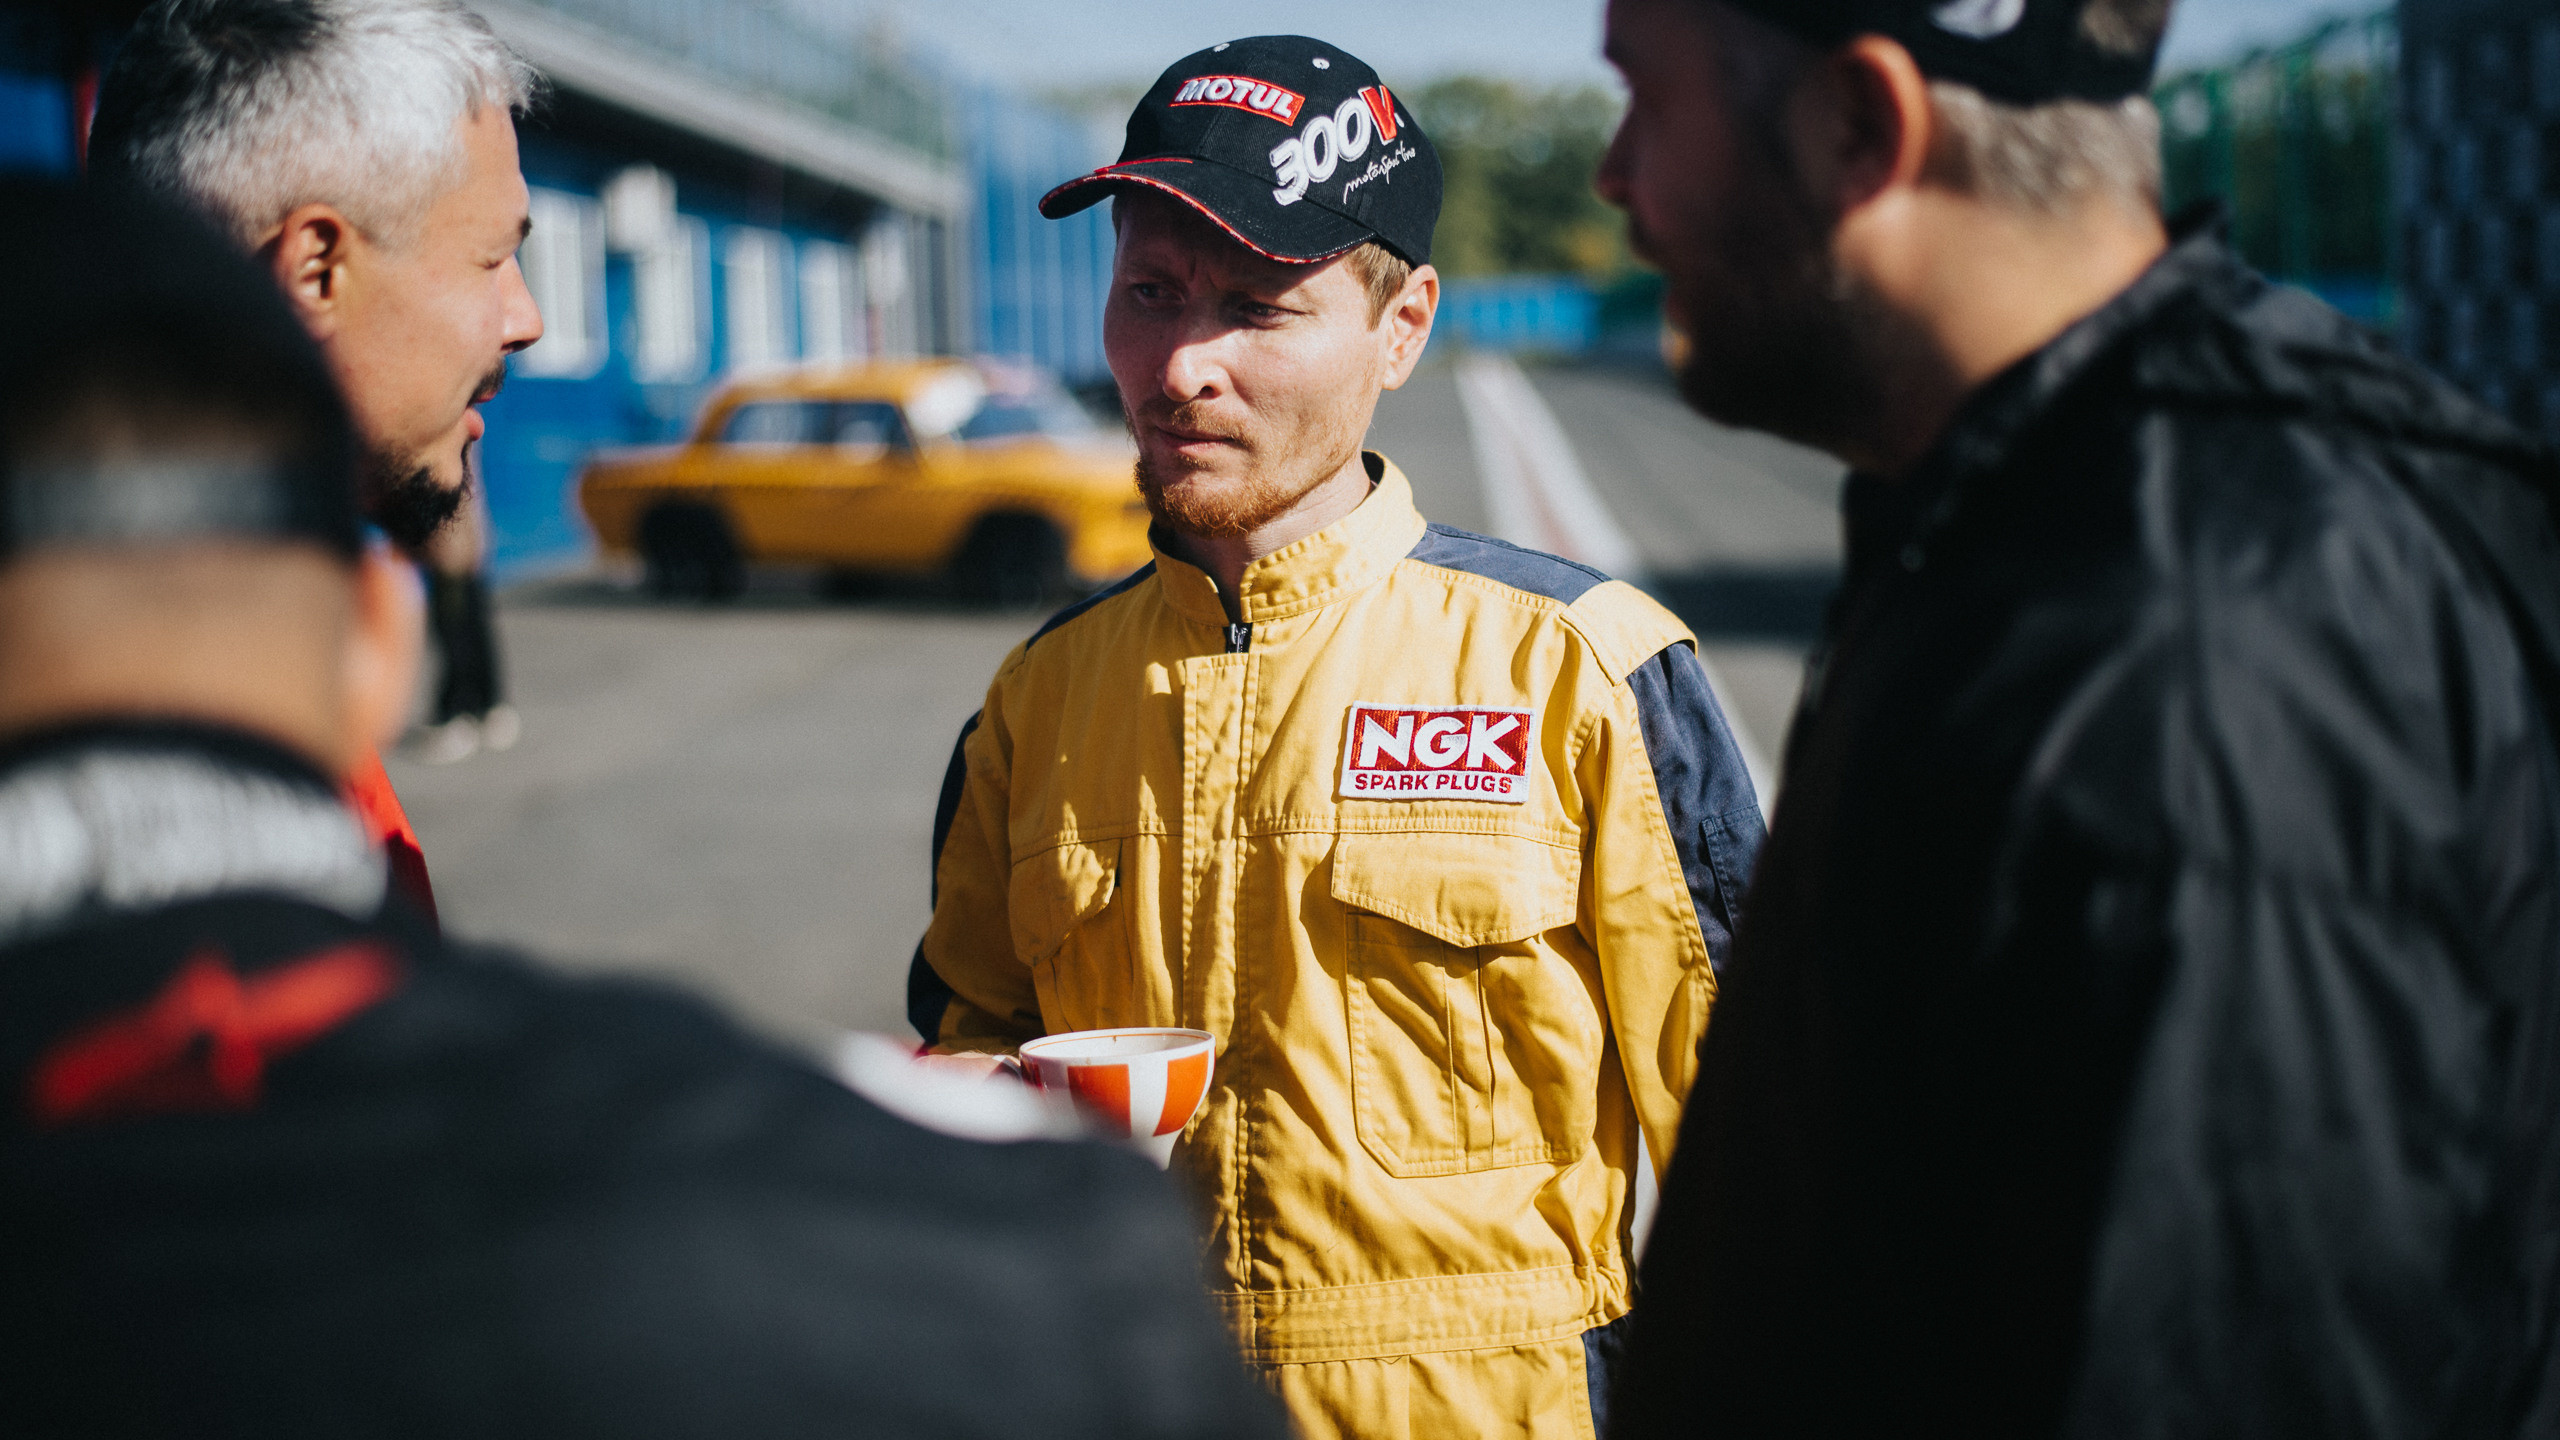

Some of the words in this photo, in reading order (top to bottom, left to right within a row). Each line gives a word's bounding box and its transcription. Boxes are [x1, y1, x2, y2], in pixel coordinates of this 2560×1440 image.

[1174, 77, 1294, 119] MOTUL
[1269, 85, 1397, 206] 300V
[1358, 714, 1521, 771] NGK
[1354, 773, 1429, 791] SPARK
[1435, 774, 1513, 794] PLUGS
